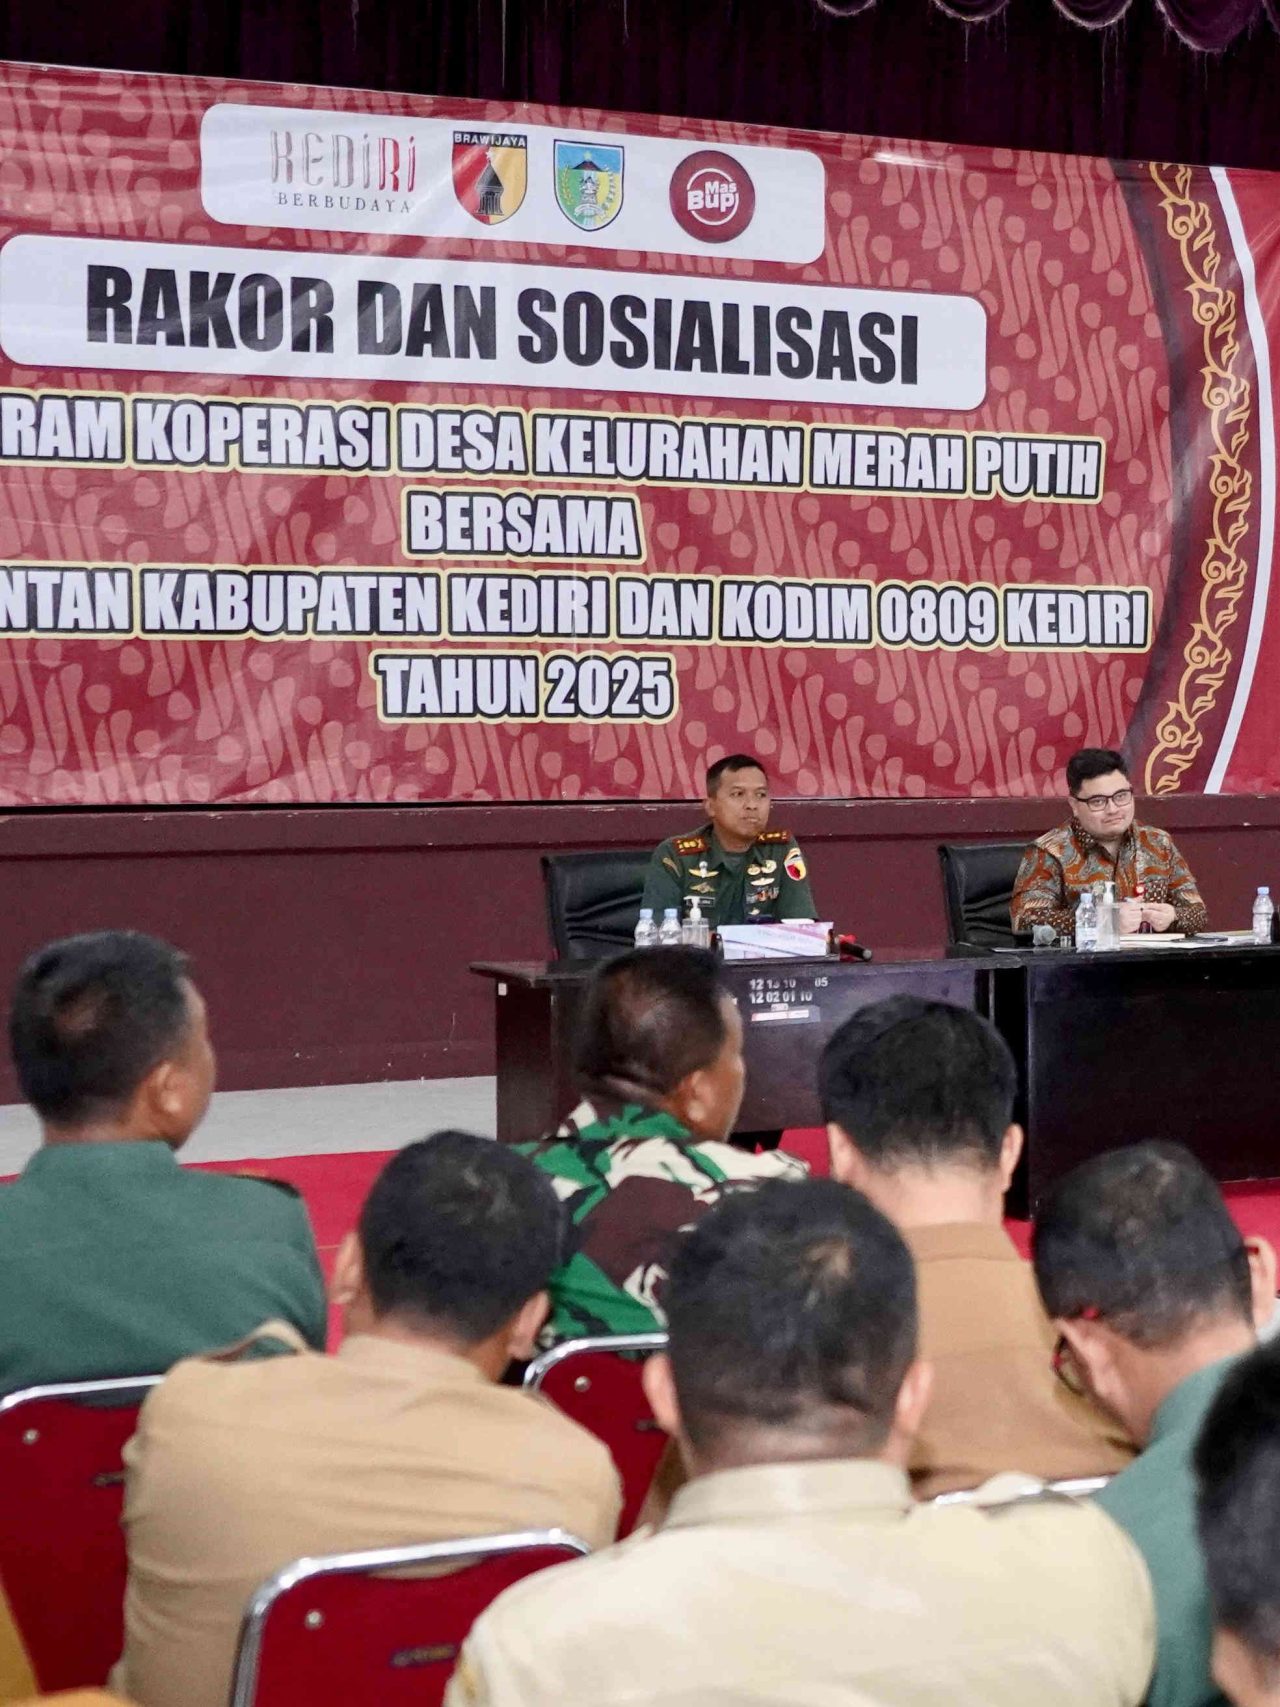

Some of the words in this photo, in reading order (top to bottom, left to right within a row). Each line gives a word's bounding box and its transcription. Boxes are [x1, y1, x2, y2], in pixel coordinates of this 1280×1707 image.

[453, 132, 527, 147] BRAWIJAYA
[704, 181, 737, 194] Mas
[278, 192, 411, 214] BERBUDAYA
[687, 190, 735, 213] Bup
[86, 264, 334, 352] RAKOR
[356, 279, 498, 361] DAN
[516, 287, 920, 385] SOSIALISASI
[134, 399, 391, 468] KOPERASI
[400, 408, 525, 472] DESA
[534, 415, 803, 482] KELURAHAN
[812, 427, 965, 492] MERAH
[973, 438, 1101, 498] PUTIH
[410, 494, 640, 556] BERSAMA
[141, 569, 440, 634] KABUPATEN
[449, 574, 607, 638] KEDIRI
[617, 579, 711, 639] DAN
[720, 583, 872, 642] KODIM
[879, 586, 997, 644] 0809
[1004, 590, 1147, 645] KEDIRI
[377, 657, 537, 715] TAHUN
[547, 659, 672, 716] 2025
[750, 979, 764, 990] 12
[750, 991, 764, 1004] 12
[766, 991, 780, 1002] 02
[783, 991, 795, 1002] 01
[800, 991, 813, 1001] 10
